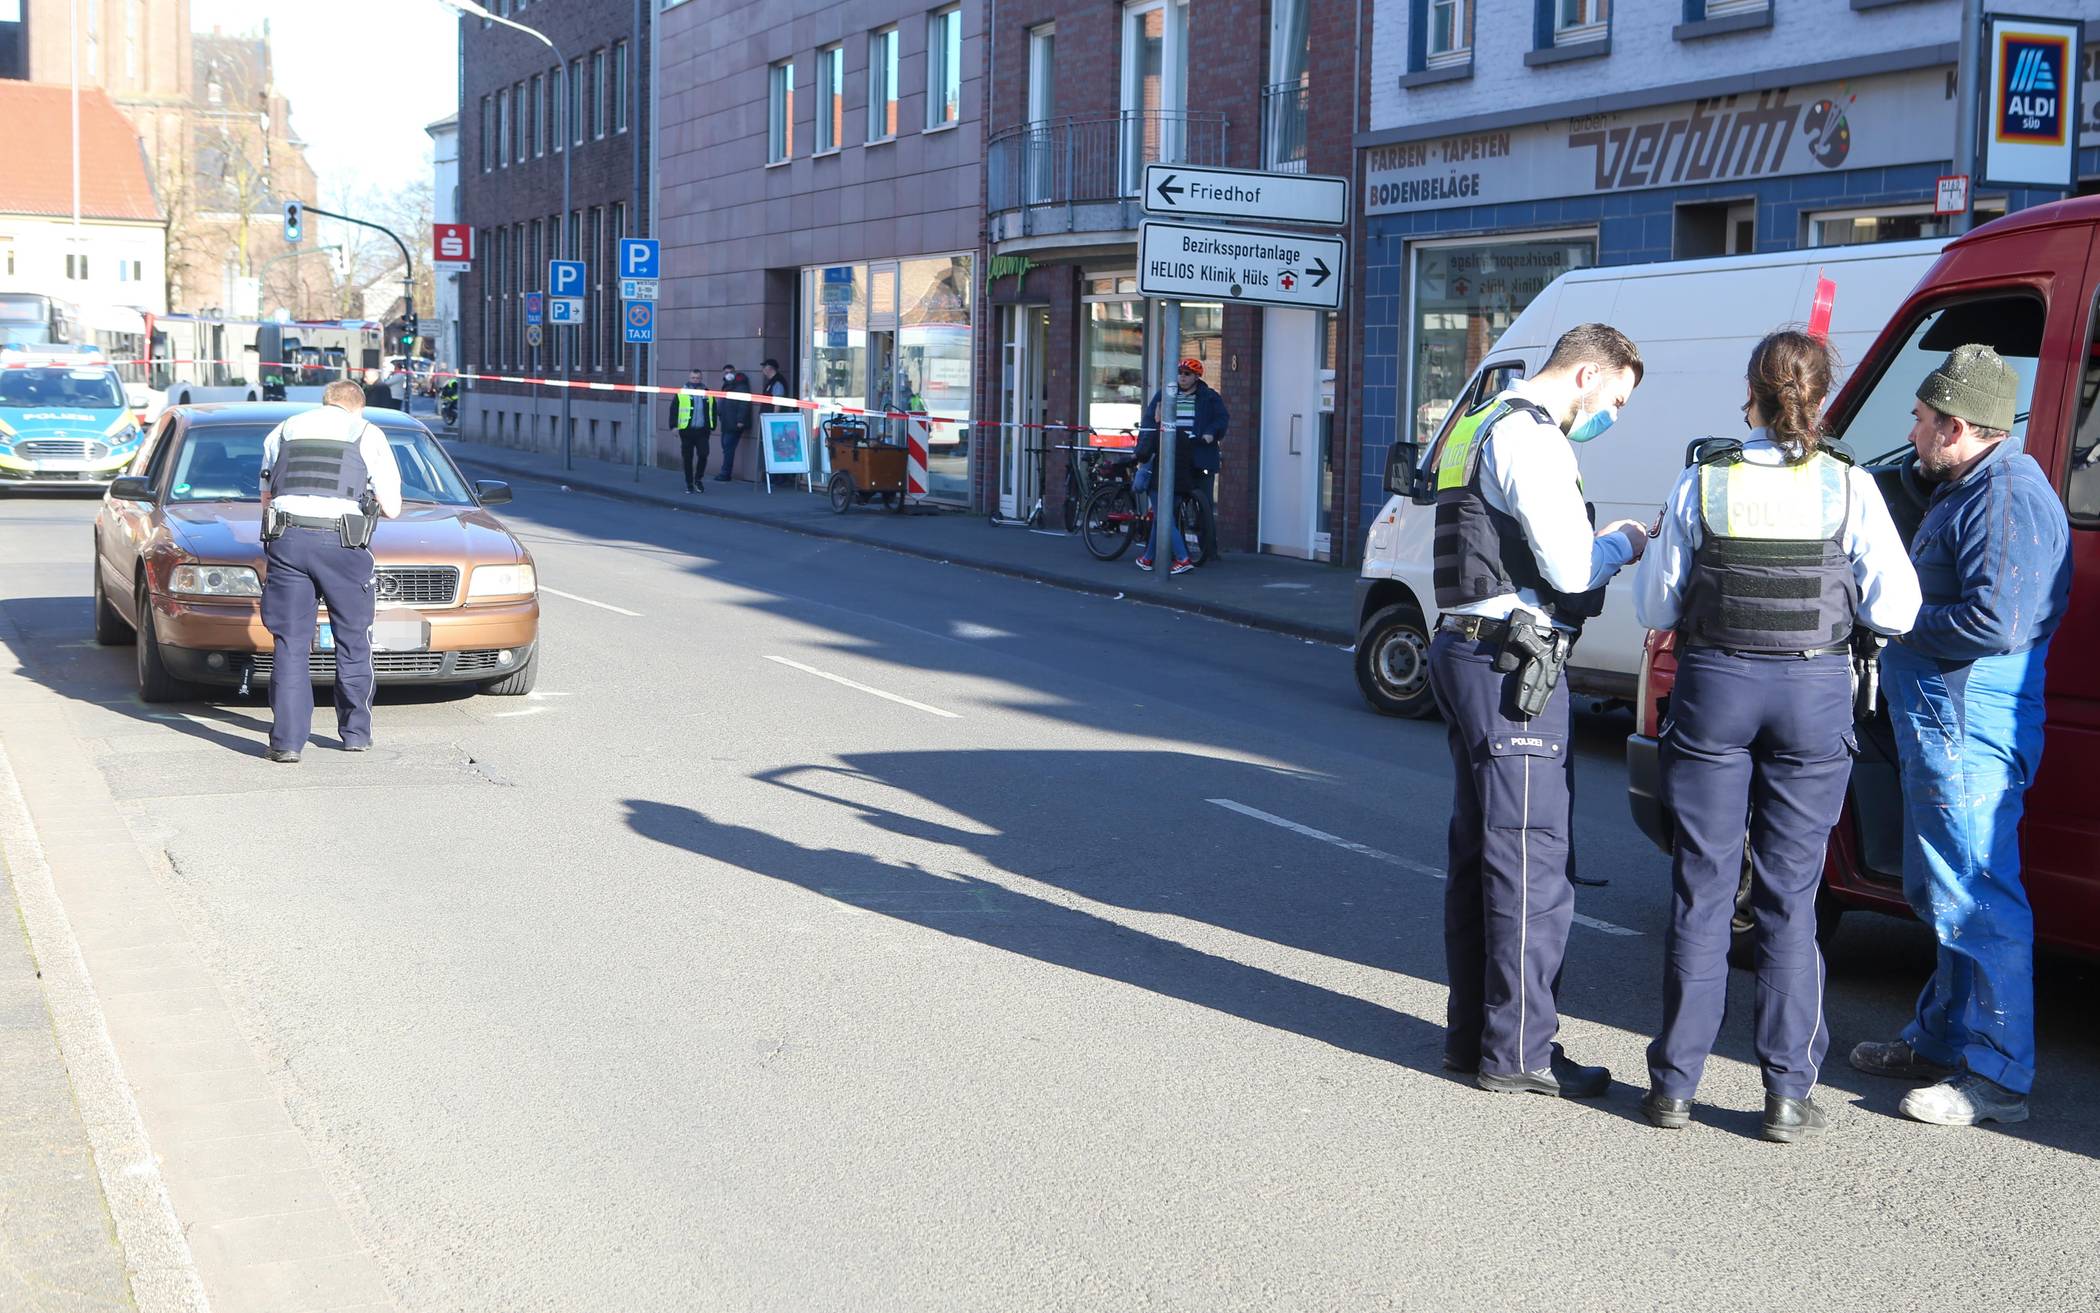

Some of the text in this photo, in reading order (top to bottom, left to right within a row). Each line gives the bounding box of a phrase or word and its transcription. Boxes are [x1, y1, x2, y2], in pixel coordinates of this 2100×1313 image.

[2008, 95, 2056, 118] ALDI
[2022, 118, 2041, 130] SÜD
[1371, 133, 1511, 172] FARBEN TAPETEN
[1190, 182, 1261, 203] Friedhof
[1370, 169, 1480, 207] BODENBELÄGE
[629, 243, 651, 273] P
[1183, 236, 1300, 265] Bezirkssportanlage
[558, 265, 577, 292] P
[1151, 261, 1269, 286] HELIOS Klinik Hüls
[554, 303, 565, 318] P
[628, 329, 651, 339] TAXI
[1231, 354, 1237, 371] 8
[1510, 736, 1543, 747] POLIZEI
